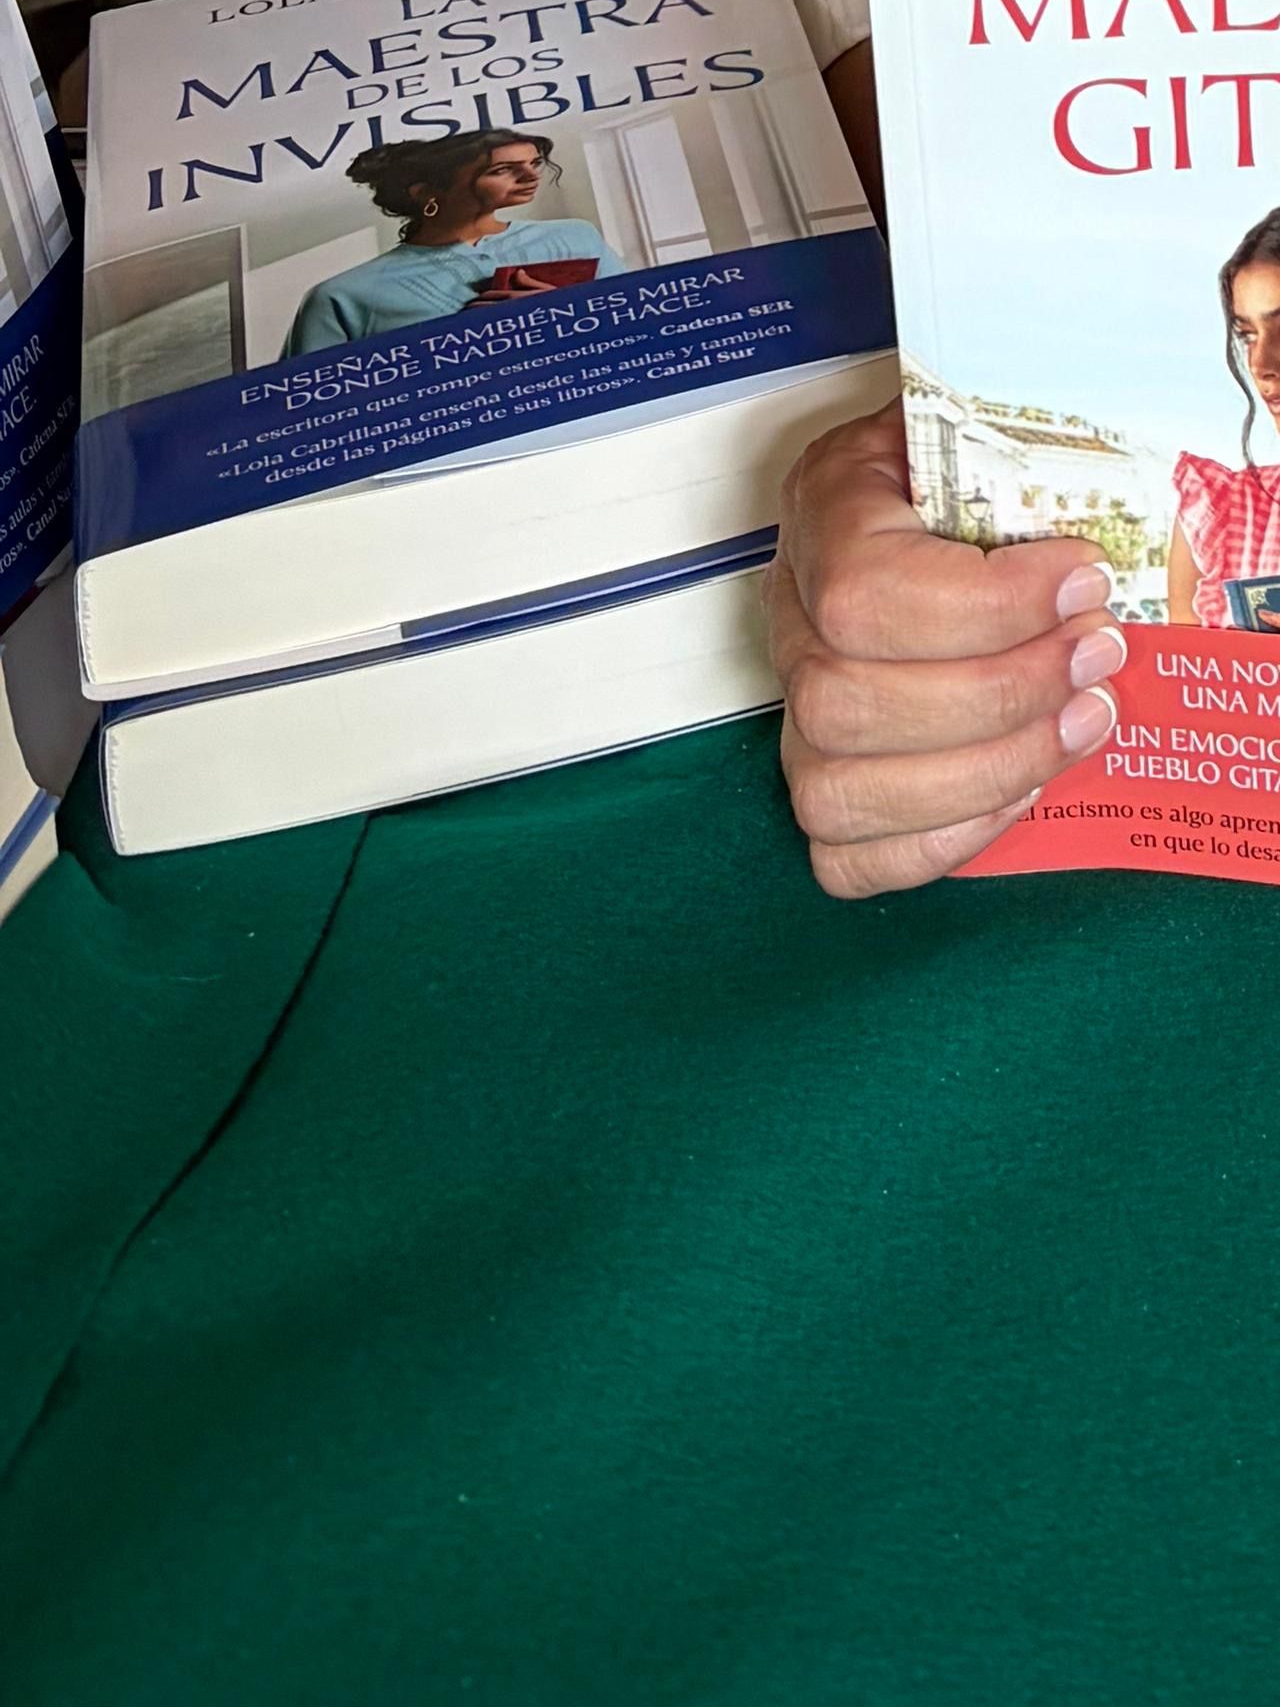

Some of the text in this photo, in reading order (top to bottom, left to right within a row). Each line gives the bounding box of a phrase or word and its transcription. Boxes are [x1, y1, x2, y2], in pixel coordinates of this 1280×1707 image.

[346, 47, 564, 110] DE LOS
[147, 49, 765, 212] INVISIBLES
[241, 267, 746, 405] ENSEÑAR TAMBIÉN ES MIRAR
[286, 293, 711, 411] DONDE NADIE LO HACE.
[1156, 652, 1223, 681] UNA
[1182, 685, 1248, 714] UNA
[1115, 715, 1161, 749] UN
[1105, 753, 1221, 785] PUEBLO
[1042, 804, 1134, 820] racismo
[1140, 808, 1163, 821] es
[1169, 811, 1216, 848] algo
[1130, 833, 1157, 848] en
[1163, 835, 1205, 854] que
[1211, 836, 1230, 856] lo
